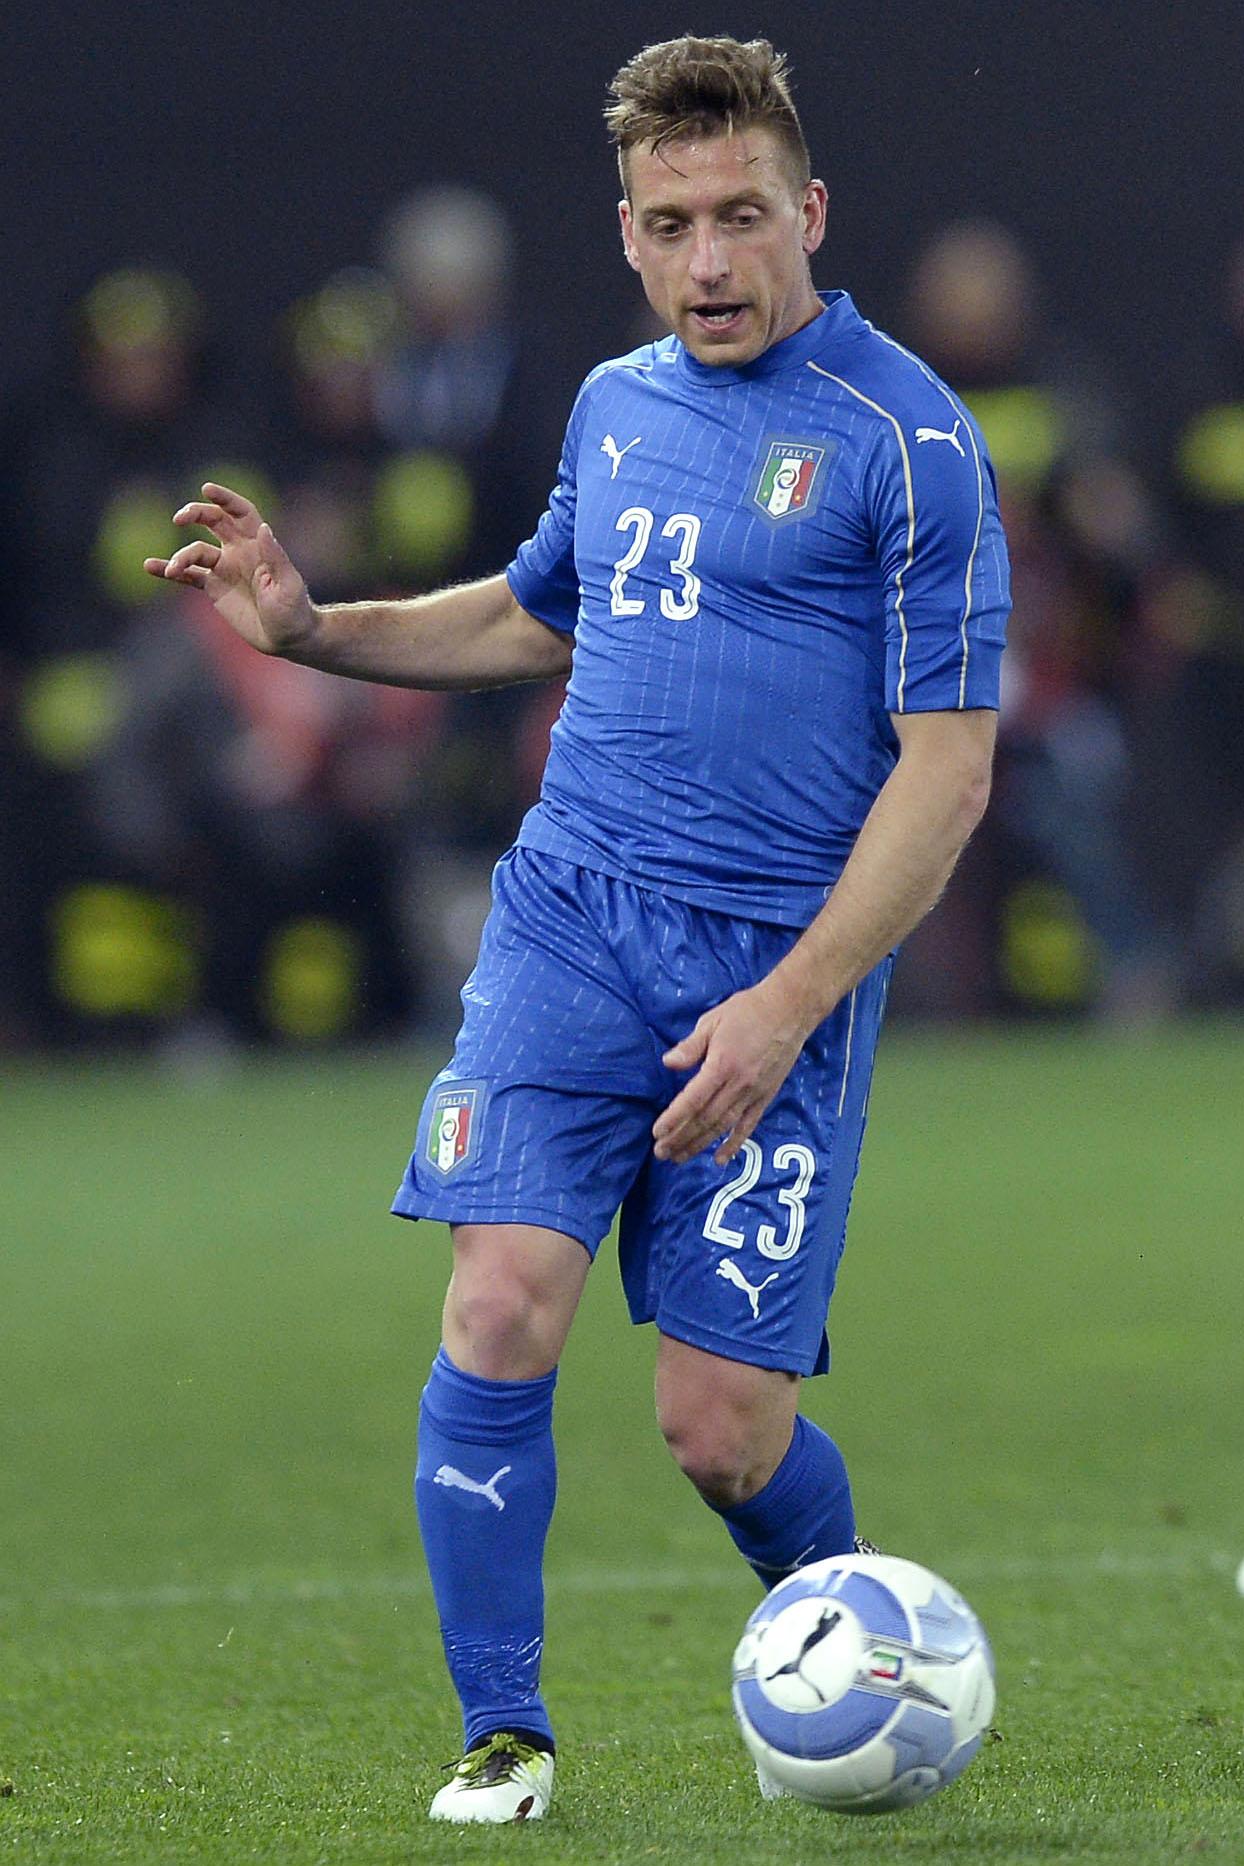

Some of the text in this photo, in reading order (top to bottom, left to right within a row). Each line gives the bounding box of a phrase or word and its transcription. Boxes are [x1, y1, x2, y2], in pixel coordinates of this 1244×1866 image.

[775, 448, 814, 459] ITALIA
[609, 506, 702, 621] 23
[439, 1096, 468, 1106] ITALIA
[702, 1138, 816, 1261] 23
